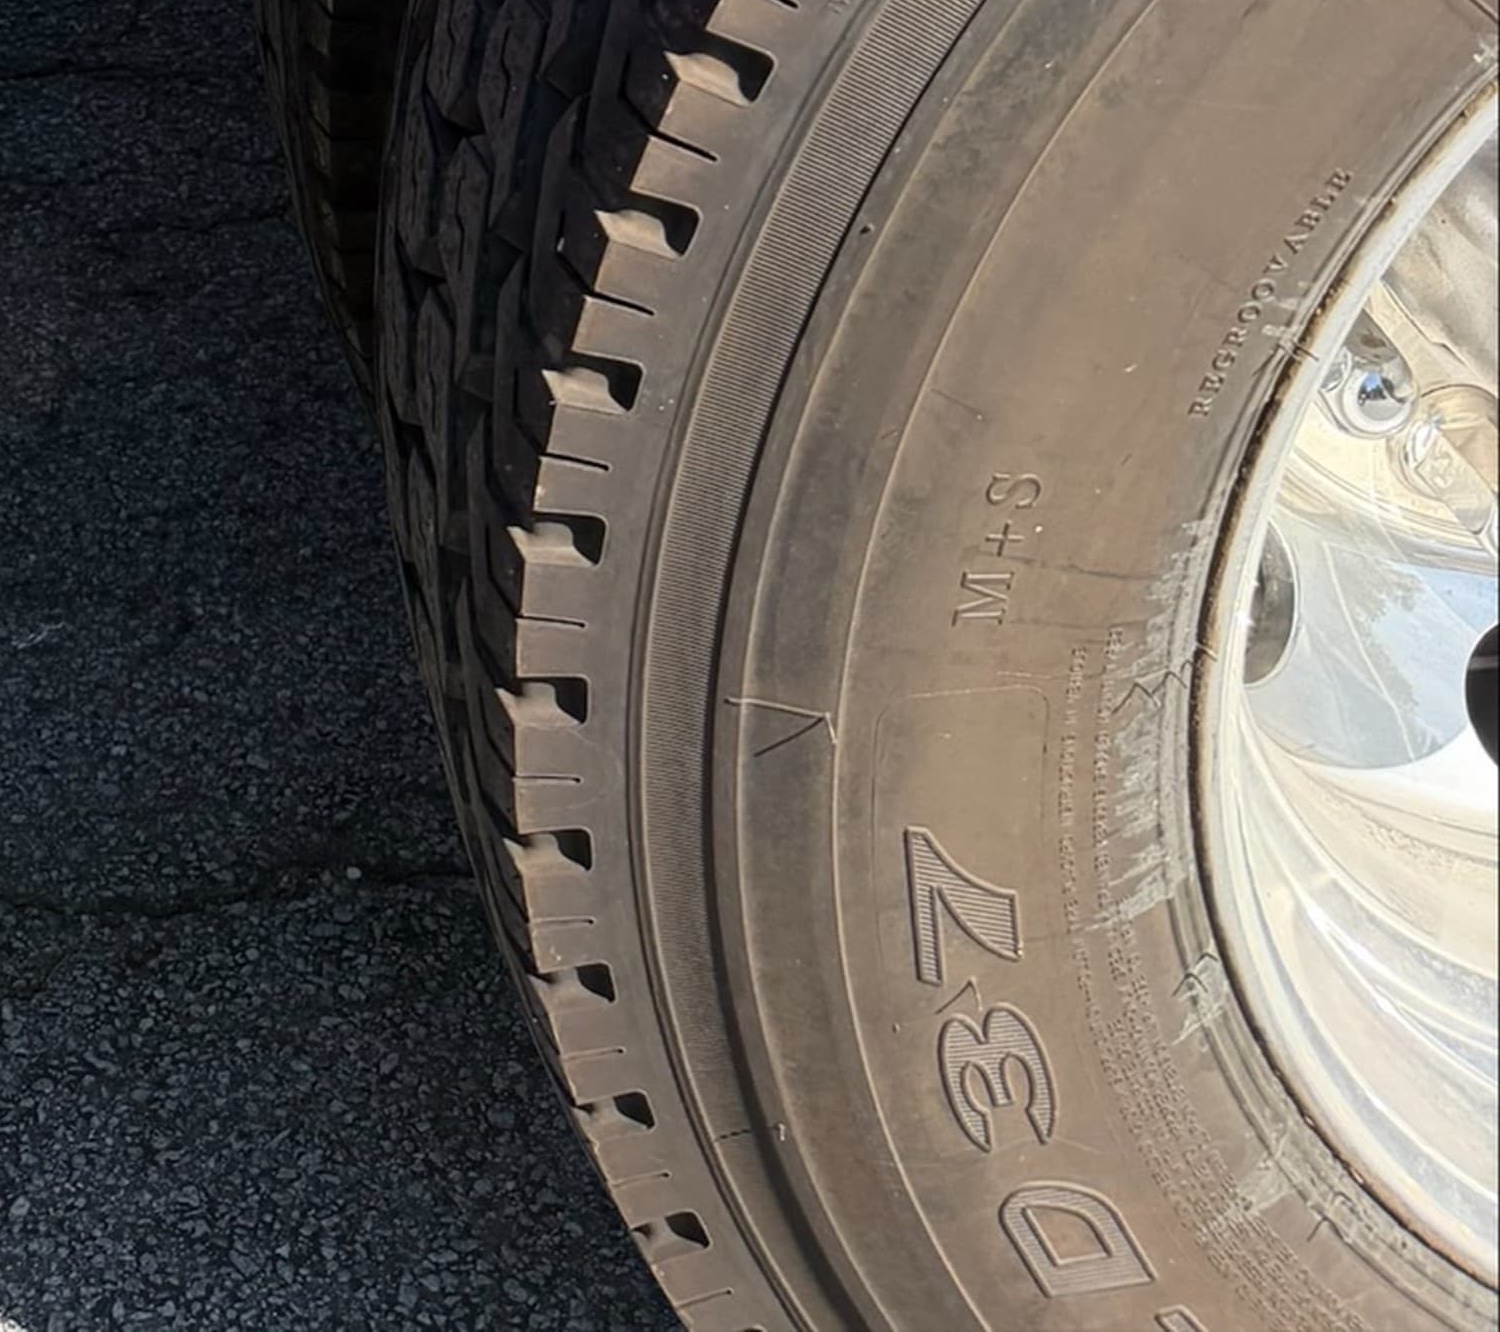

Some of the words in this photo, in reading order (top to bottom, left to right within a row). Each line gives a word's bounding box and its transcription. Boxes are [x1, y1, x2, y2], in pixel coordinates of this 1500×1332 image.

[1188, 167, 1354, 417] REGROOVABLE
[952, 472, 1044, 626] M+S
[905, 825, 1208, 1332] D37
